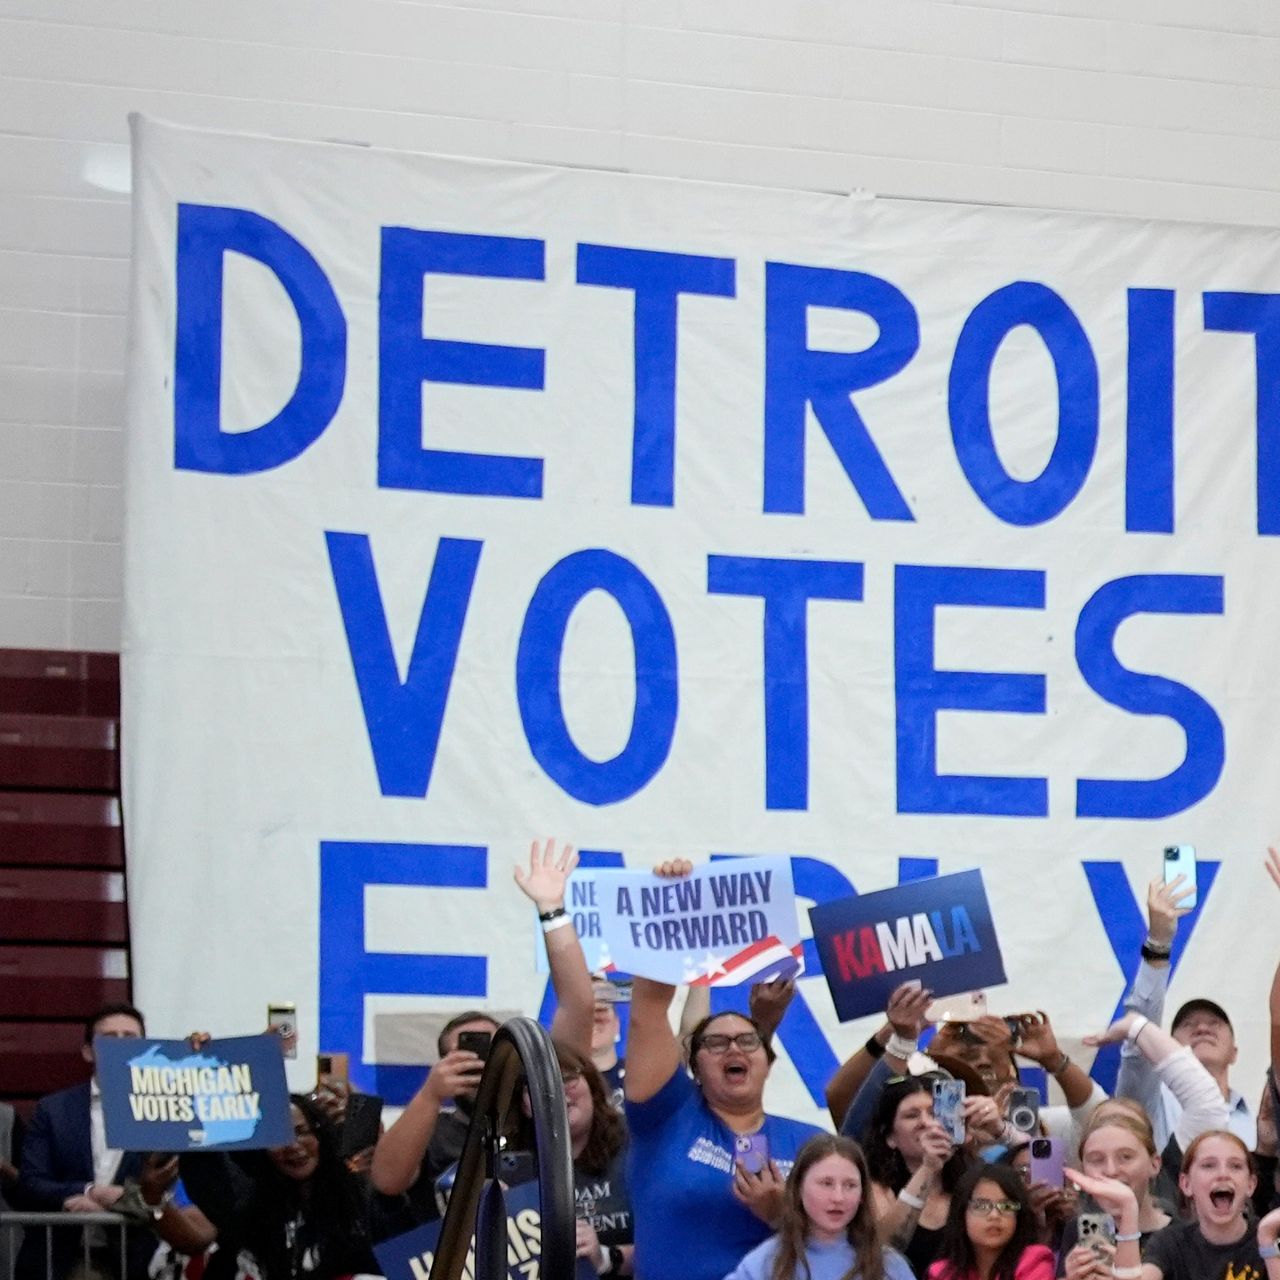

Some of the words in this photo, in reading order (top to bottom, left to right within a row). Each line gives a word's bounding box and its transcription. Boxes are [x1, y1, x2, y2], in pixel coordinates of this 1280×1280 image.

[323, 530, 1227, 820] VOTES
[571, 881, 598, 907] NE
[616, 886, 634, 917] A
[640, 877, 704, 917] NEW
[708, 870, 773, 908] WAY
[629, 910, 769, 950] FORWARD
[832, 905, 982, 983] KAMALA
[130, 1063, 253, 1095] MICHIGAN
[129, 1092, 195, 1122] VOTES
[198, 1091, 260, 1121] EARLY
